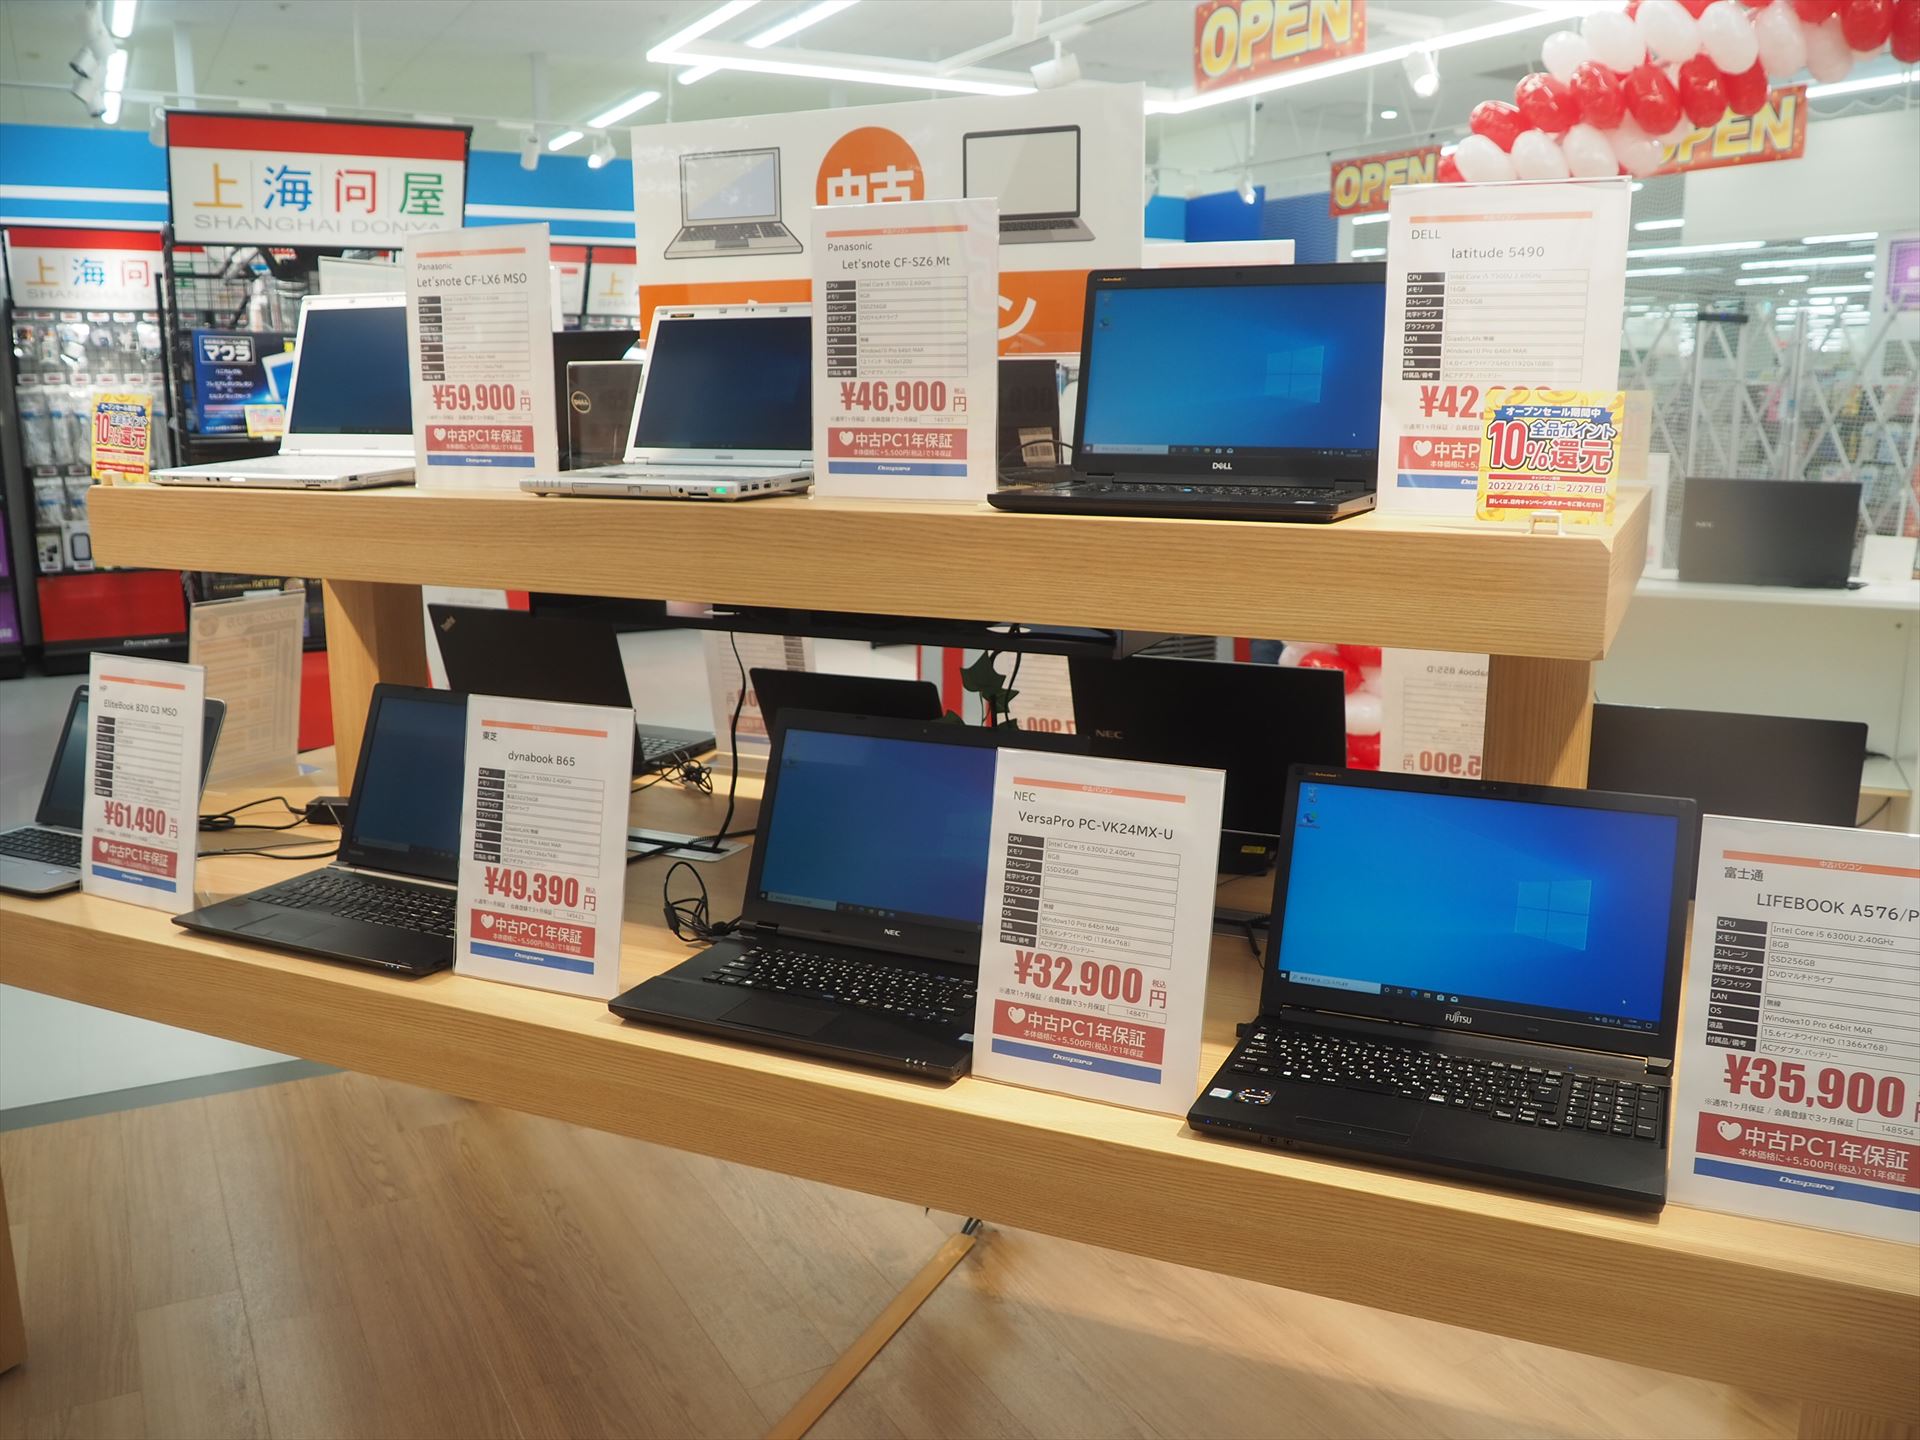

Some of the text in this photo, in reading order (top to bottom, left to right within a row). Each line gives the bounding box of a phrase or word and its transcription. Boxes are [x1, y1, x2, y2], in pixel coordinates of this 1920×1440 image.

[1201, 0, 1353, 78] OPEN
[194, 214, 341, 234] SHANGHAI
[1411, 229, 1441, 240] DELL
[827, 241, 873, 252] Panasonic
[1451, 246, 1545, 259] latitude 5490
[418, 263, 453, 272] Panasonic
[842, 256, 950, 270] Let'snote CF-SZ6 Mt
[417, 273, 528, 288] Let'snote CF-LX6 MSO
[433, 384, 515, 411] ¥59,900
[841, 381, 967, 412] ¥46,900 円
[1506, 407, 1601, 418] オープンセール期間中
[447, 428, 523, 443] 中古PC1年保証
[1530, 420, 1616, 439] 全品ポイント
[855, 432, 953, 448] 中古PC1年保証
[1212, 462, 1233, 470] DELL
[104, 699, 134, 710] EliteBook
[136, 703, 149, 713] 820
[150, 705, 160, 714] G3
[482, 731, 498, 742] 東芝
[1095, 729, 1123, 739] NEC
[508, 751, 576, 766] dynabook B65
[1013, 791, 1036, 802] NEC
[104, 801, 166, 835] ¥61,490
[1018, 811, 1173, 840] VersaPro PC-VK24MX-U
[1009, 835, 1022, 843] CPU
[1007, 848, 1023, 856] メモリ
[1007, 860, 1031, 869] ストレージ
[1046, 866, 1079, 876] SSD256GB
[1819, 860, 1863, 871] 中古パソコン
[1724, 866, 1764, 882] 富士通
[485, 866, 579, 908] ¥49,390
[583, 895, 596, 911] 円
[1005, 885, 1034, 895] グラフィック
[1004, 897, 1016, 905] LAN
[1757, 893, 1920, 922] LIFEBOOK A576/P
[1003, 909, 1012, 917] OS
[1718, 919, 1736, 928] CPU
[495, 917, 583, 945] 中古PC1年保証
[884, 928, 901, 937] NEC
[1773, 926, 1894, 946] Intel Core i5 6300U 2.40GHz
[1716, 934, 1737, 943] メモリ
[1772, 941, 1790, 949] 8GB
[1715, 948, 1749, 958] ストレージ
[1770, 955, 1816, 967] SSD256GB
[1714, 962, 1754, 974] 光学ドライブ
[1014, 949, 1143, 1004] ¥32,900
[1149, 989, 1167, 1009] 円
[1712, 977, 1752, 989] グラフィック
[1769, 970, 1834, 984] DVDマルチドライブ
[1152, 979, 1166, 989] 税込
[1711, 992, 1728, 1001] LAN
[1710, 1006, 1722, 1015] OS
[1445, 1012, 1472, 1025] FUJITSU
[1764, 1014, 1873, 1035] Windows10 Pro 64bit MAR
[1028, 1011, 1146, 1048] 中古PC1年保証
[1837, 1039, 1888, 1052] (1366x768)
[1052, 1053, 1093, 1066] Dospara
[1723, 1053, 1905, 1119] ¥35,900
[1774, 1107, 1854, 1128] 会員登録で3ヶ月保証
[1881, 1124, 1915, 1137] 148554
[1745, 1126, 1911, 1171] 中古PC1年保証
[1778, 1175, 1836, 1191] Dospara
